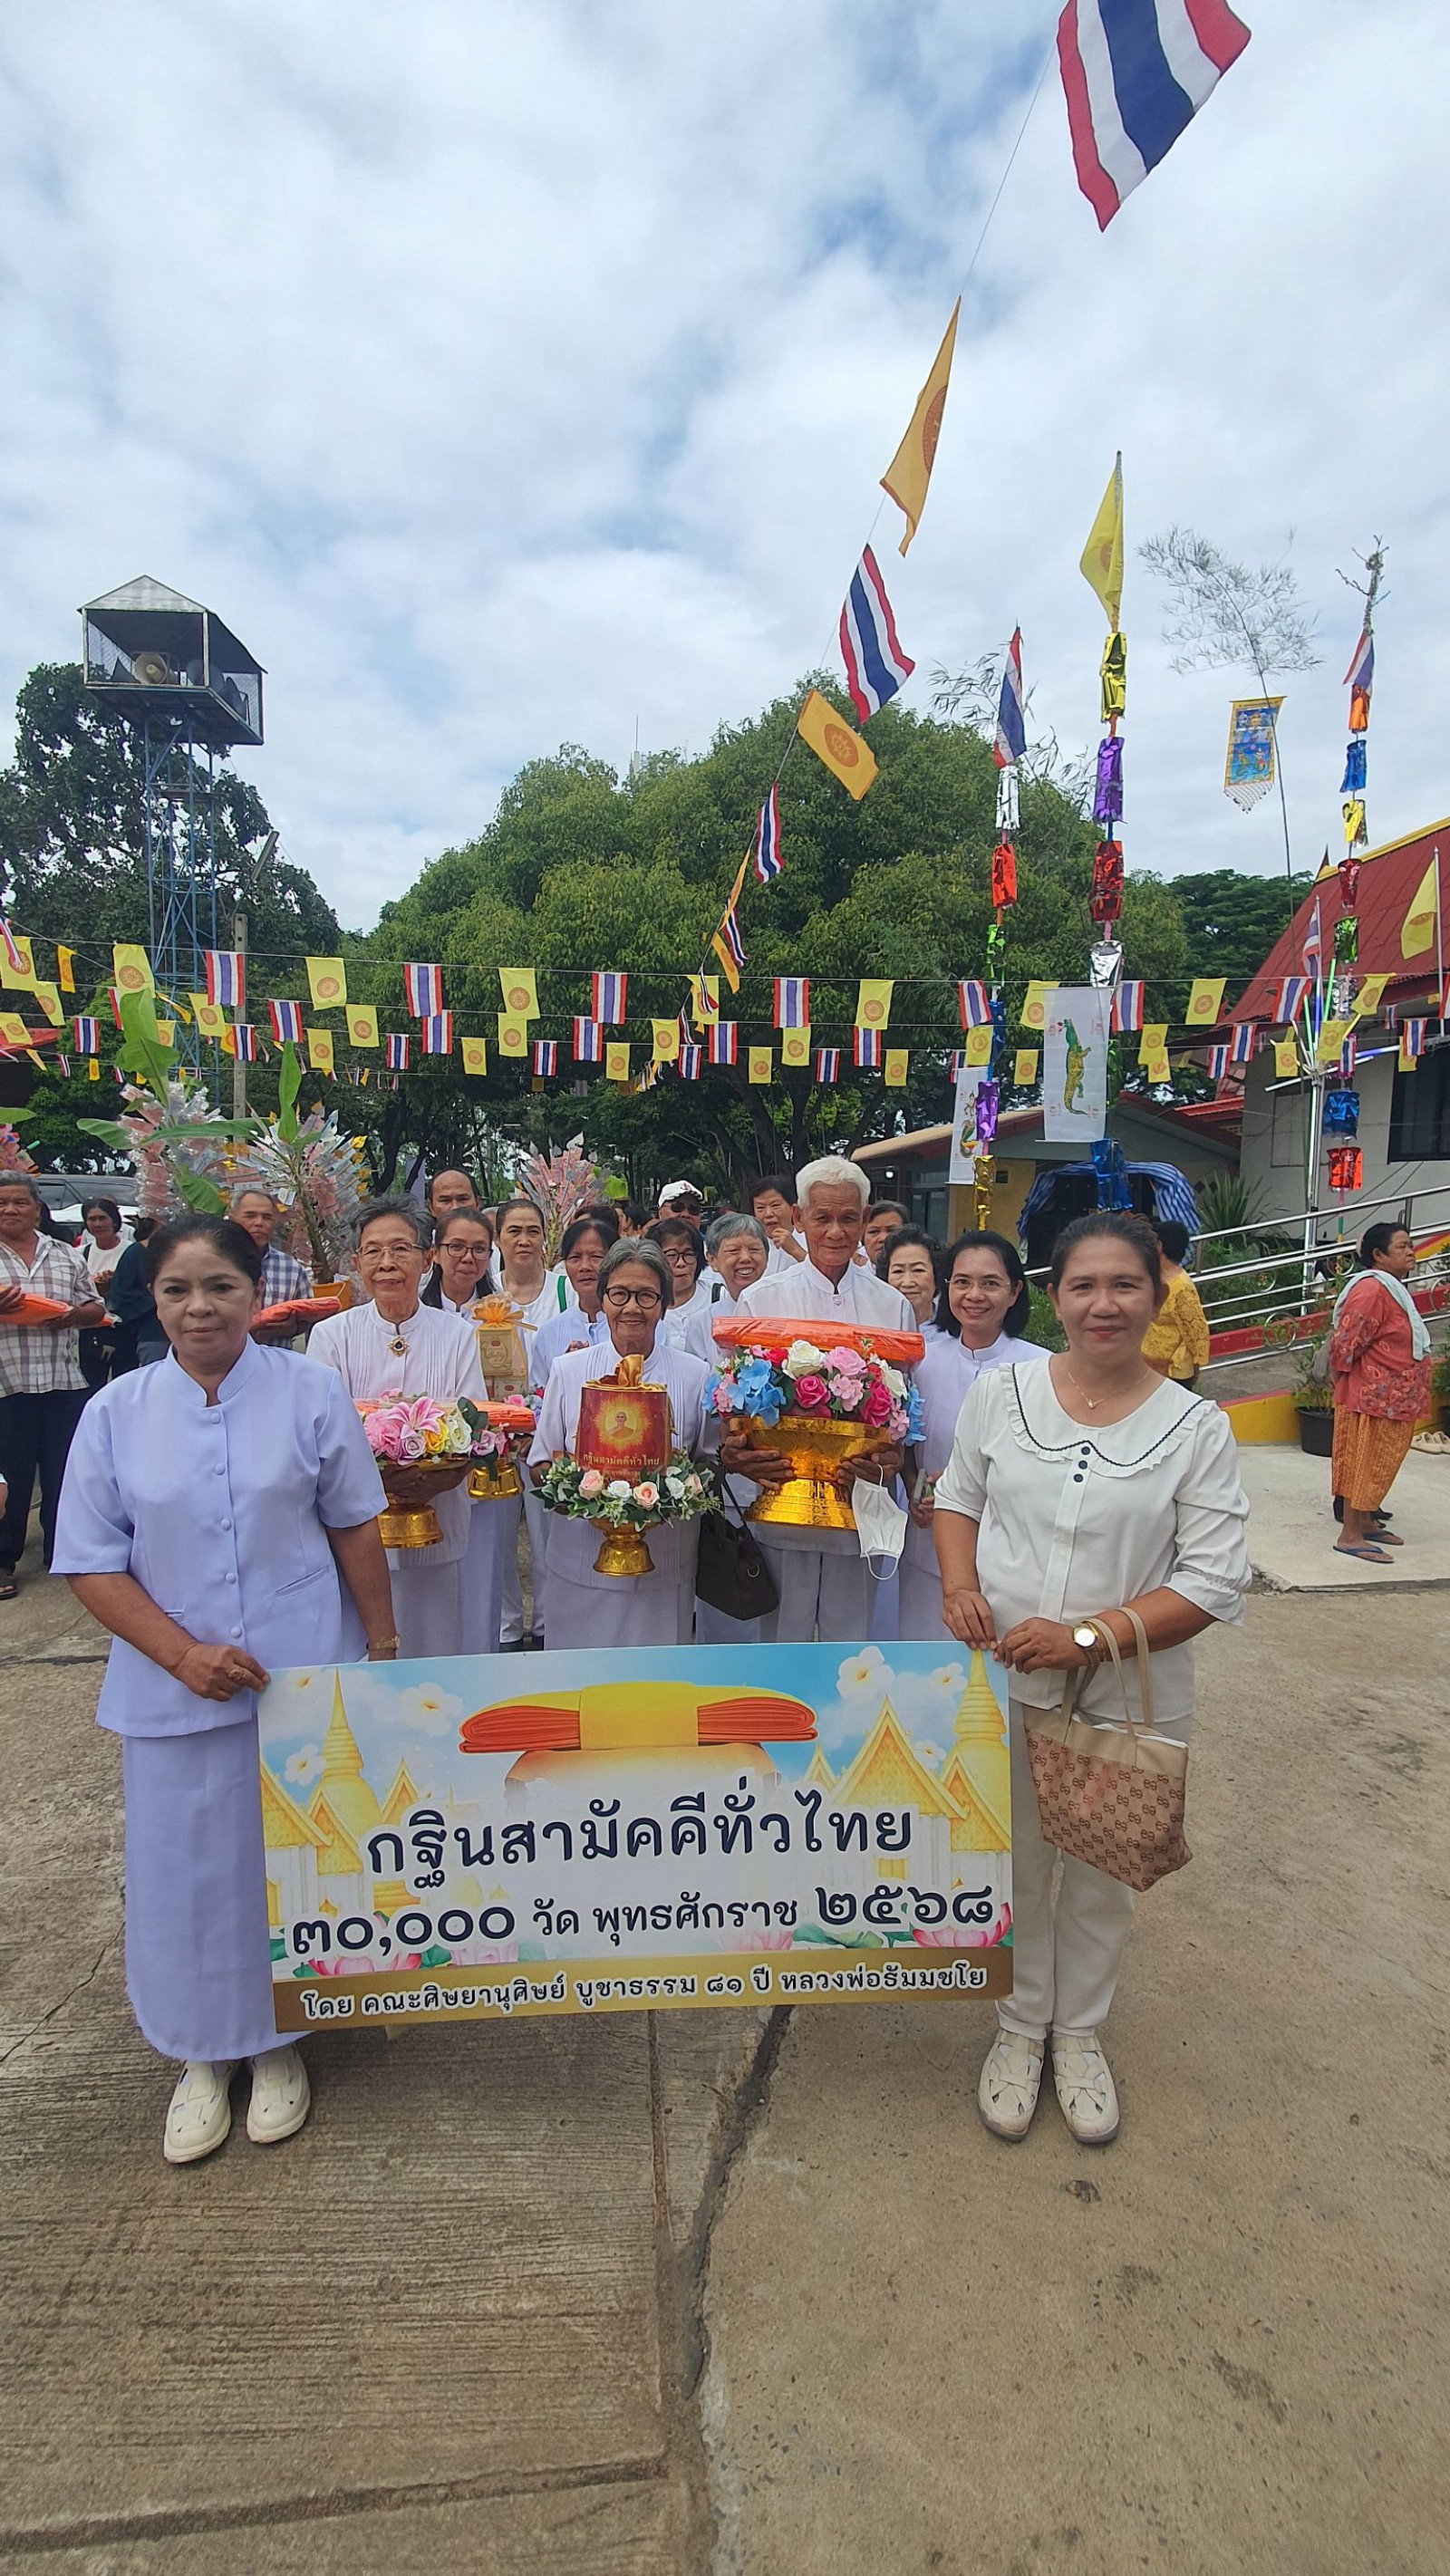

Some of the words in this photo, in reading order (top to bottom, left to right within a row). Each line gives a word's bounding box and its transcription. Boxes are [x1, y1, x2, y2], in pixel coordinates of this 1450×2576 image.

[367, 1775, 912, 1888] กฐินสามัคคีทั่วไทย
[293, 1906, 516, 1956] ๓๐,๐๐๐
[532, 1898, 579, 1936] วัด
[593, 1891, 798, 1947] พุทธศักราช
[815, 1885, 993, 1925] ๒๕๖๘
[304, 1992, 353, 2017] โดย
[364, 1973, 566, 2013] คณะศิษยานุศิษย์
[576, 1975, 695, 2006] บูชาธรรม
[707, 1975, 742, 1994] ๘๑
[753, 1964, 770, 1992] ปี
[781, 1962, 984, 1992] หลวงพ่อธัมมชโย
